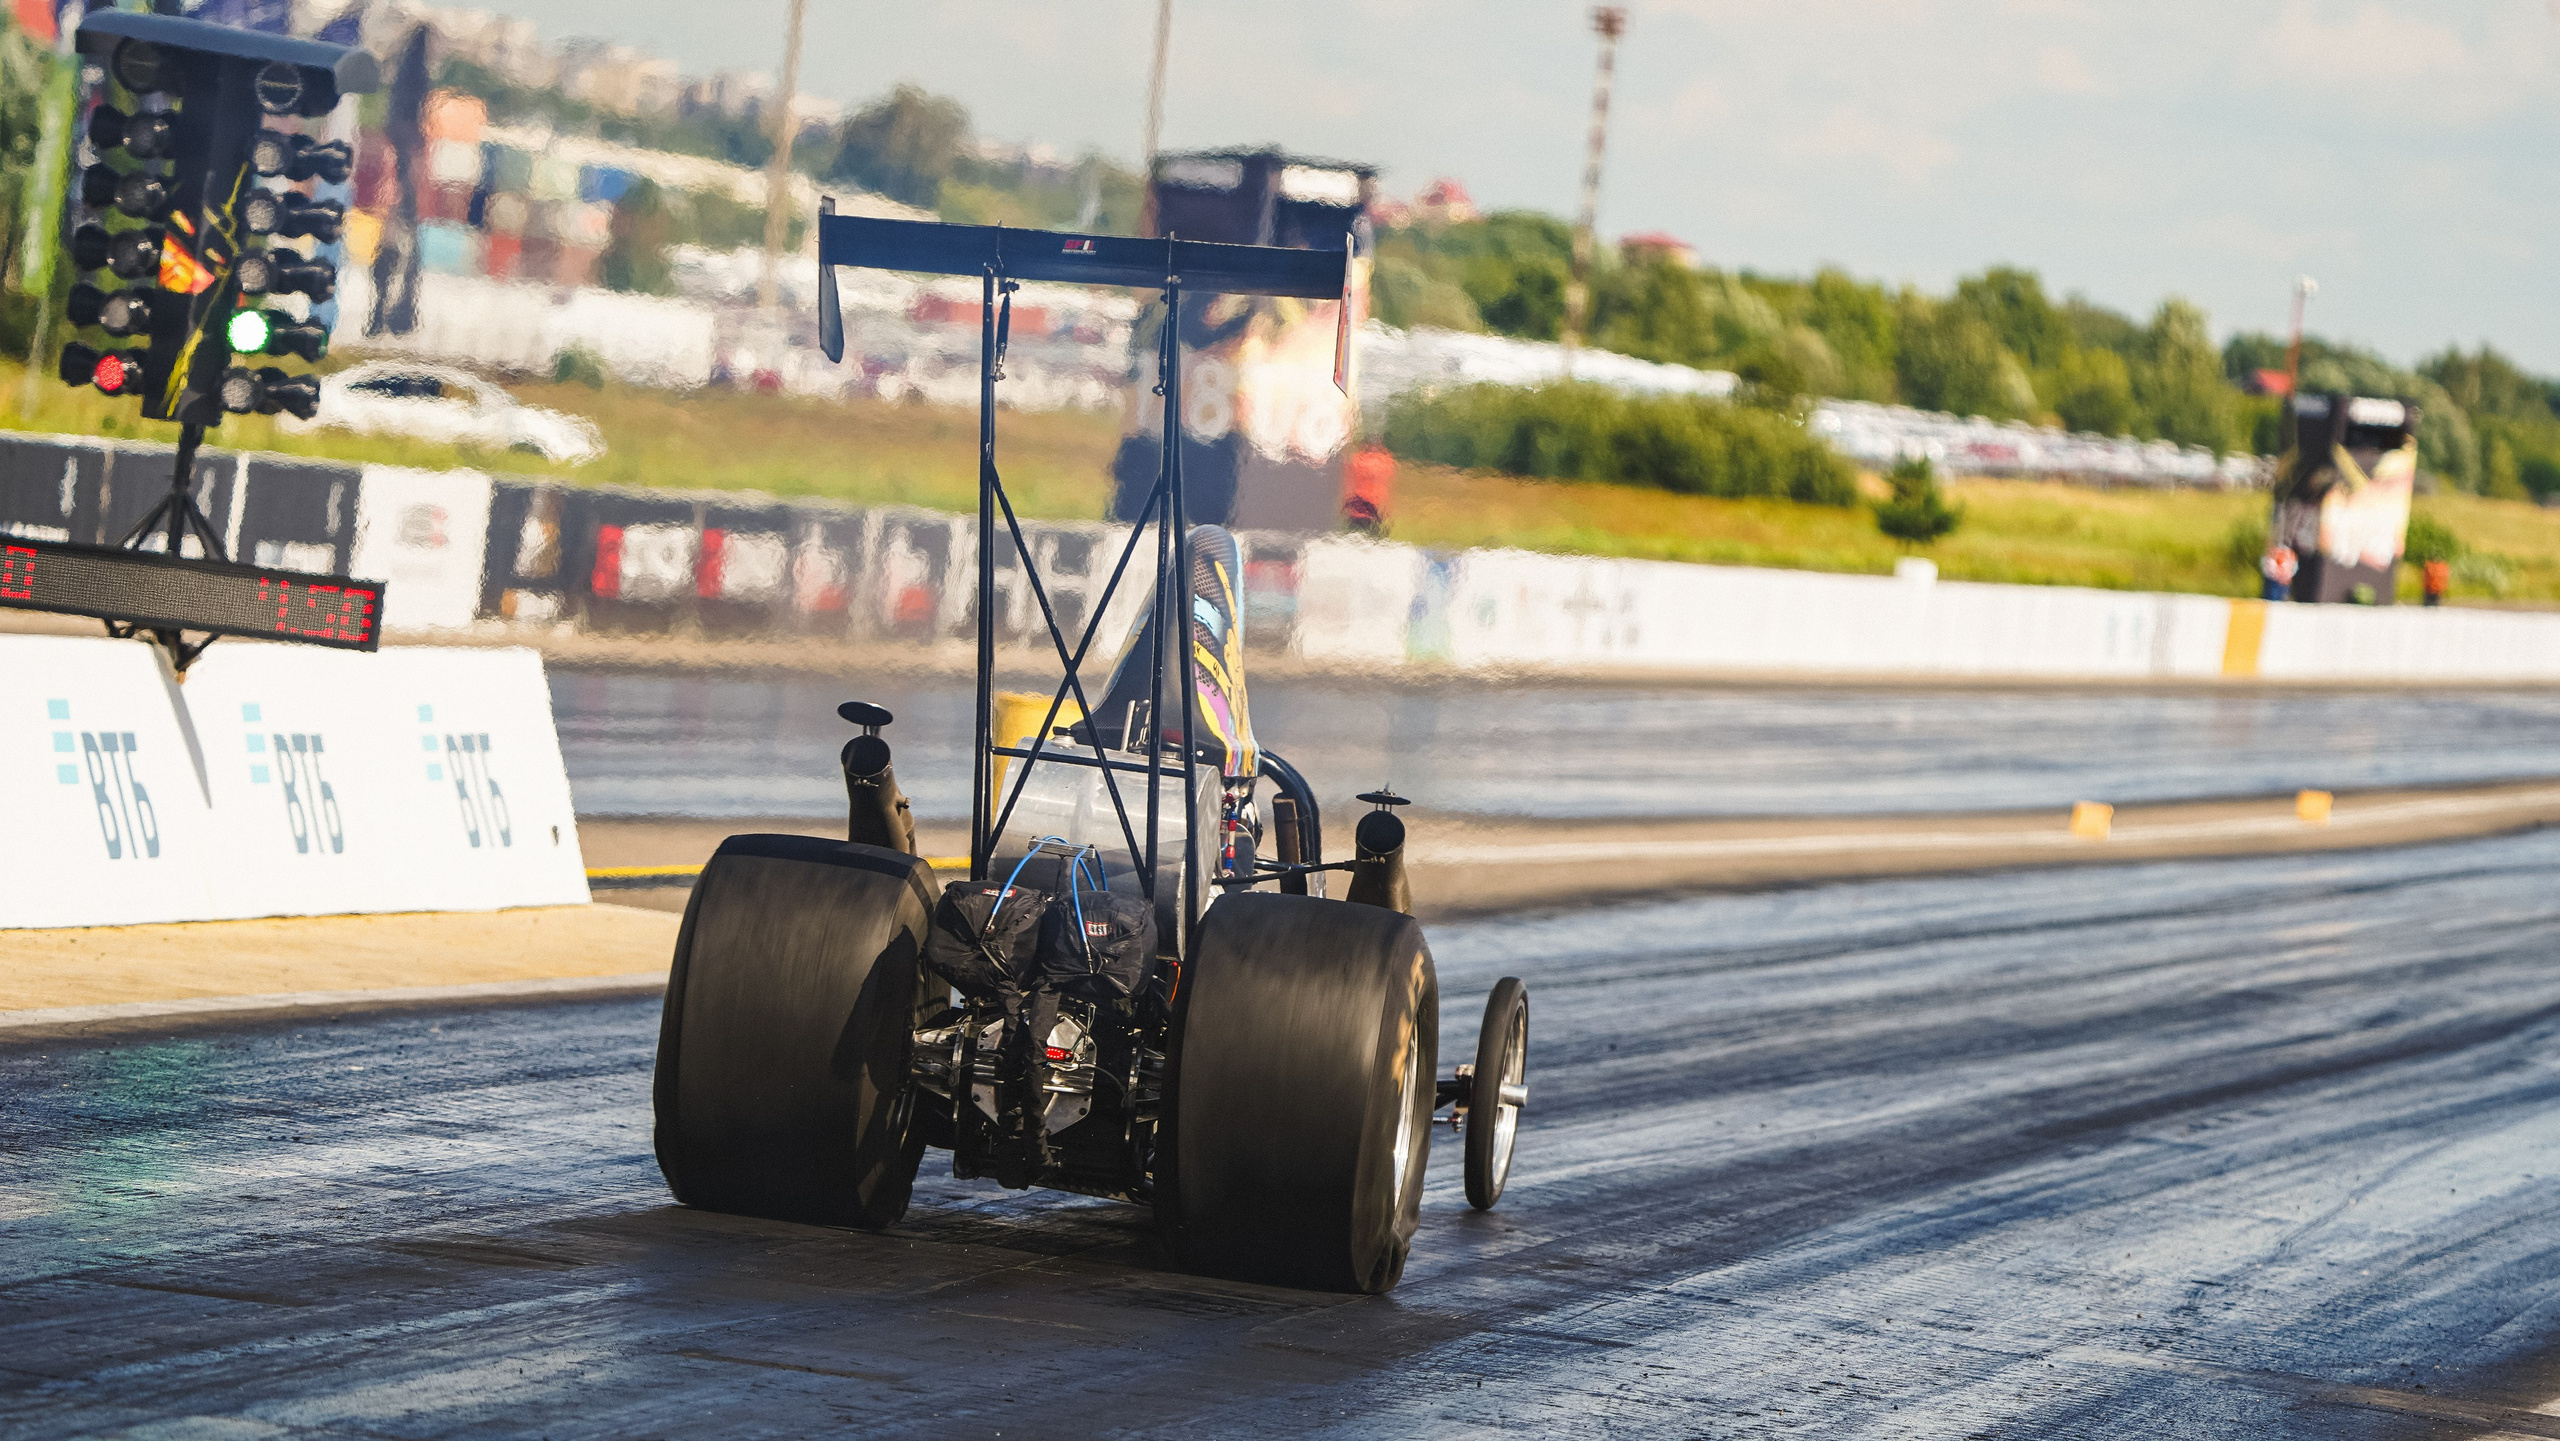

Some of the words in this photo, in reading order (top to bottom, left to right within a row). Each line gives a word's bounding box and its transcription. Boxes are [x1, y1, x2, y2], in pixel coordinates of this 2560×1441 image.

[81, 732, 159, 859] ВТБ
[273, 734, 344, 854] ВТБ
[446, 733, 512, 848] ВТБ
